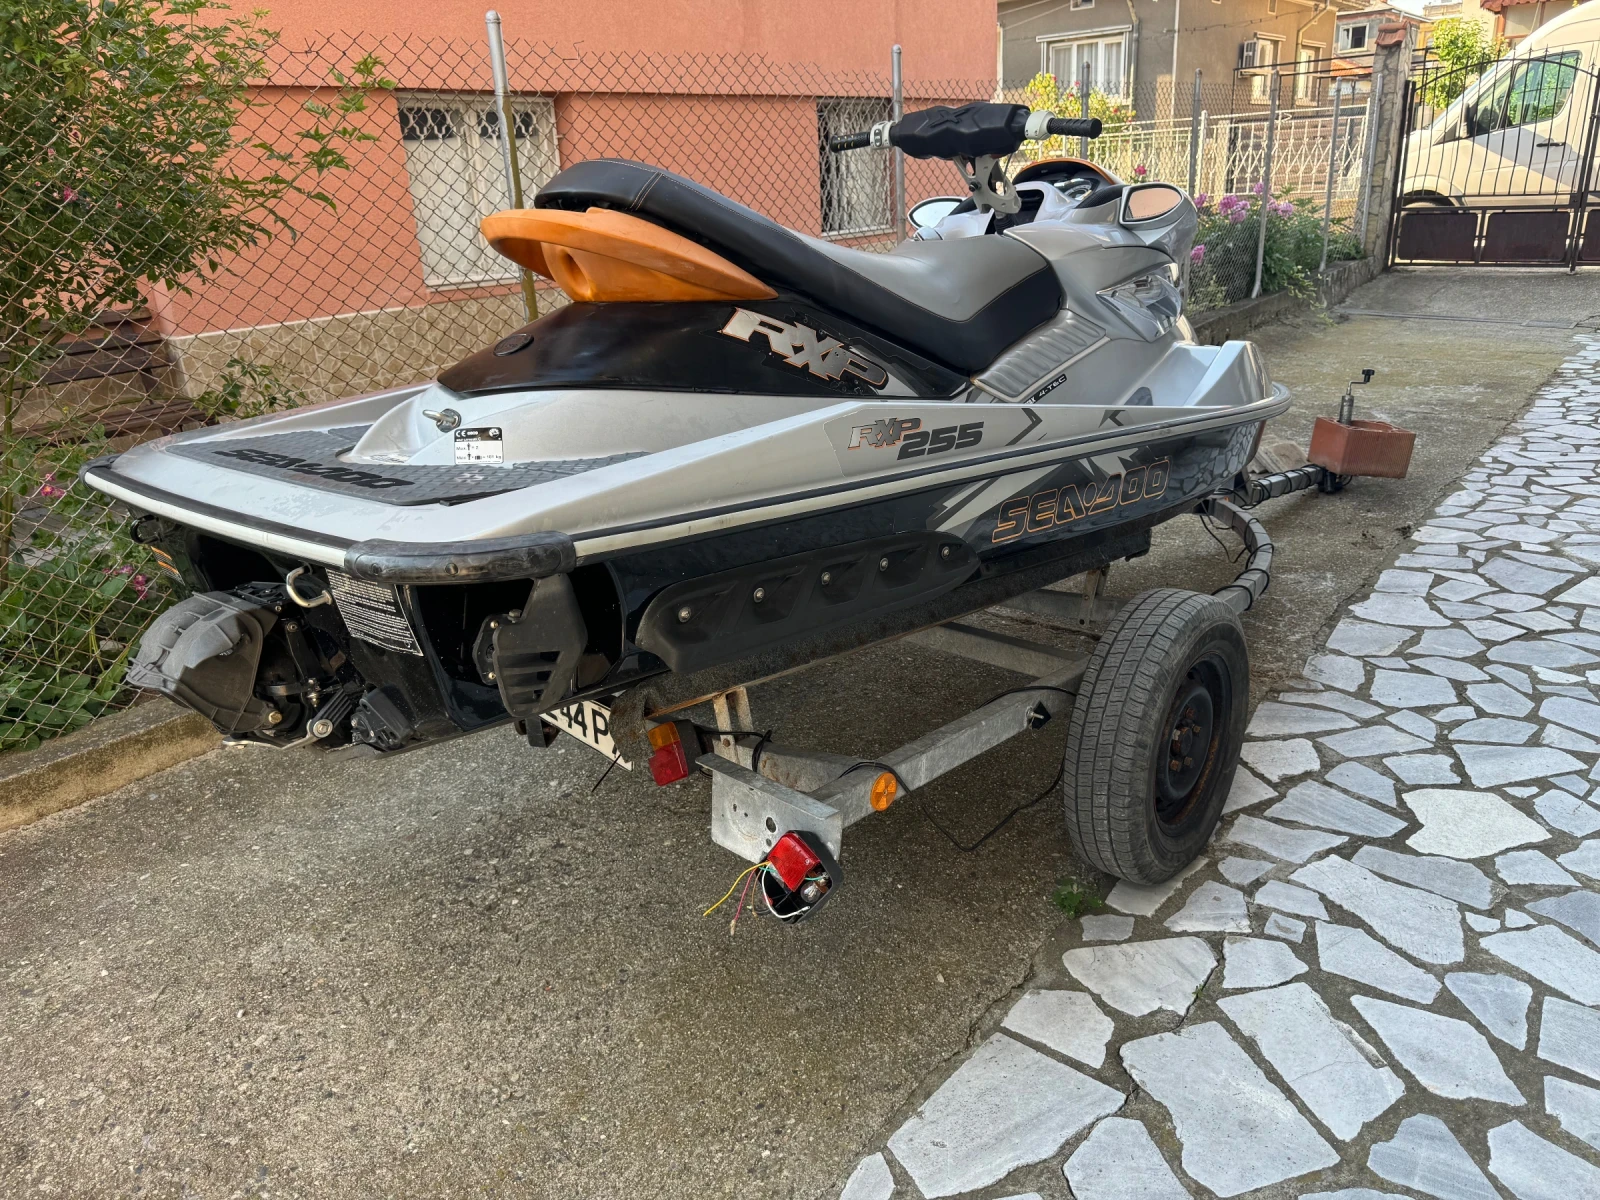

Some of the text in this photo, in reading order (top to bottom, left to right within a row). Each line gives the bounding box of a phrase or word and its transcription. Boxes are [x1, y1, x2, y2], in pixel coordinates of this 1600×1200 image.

[716, 306, 888, 387] RXP
[847, 417, 985, 461] RXP 255
